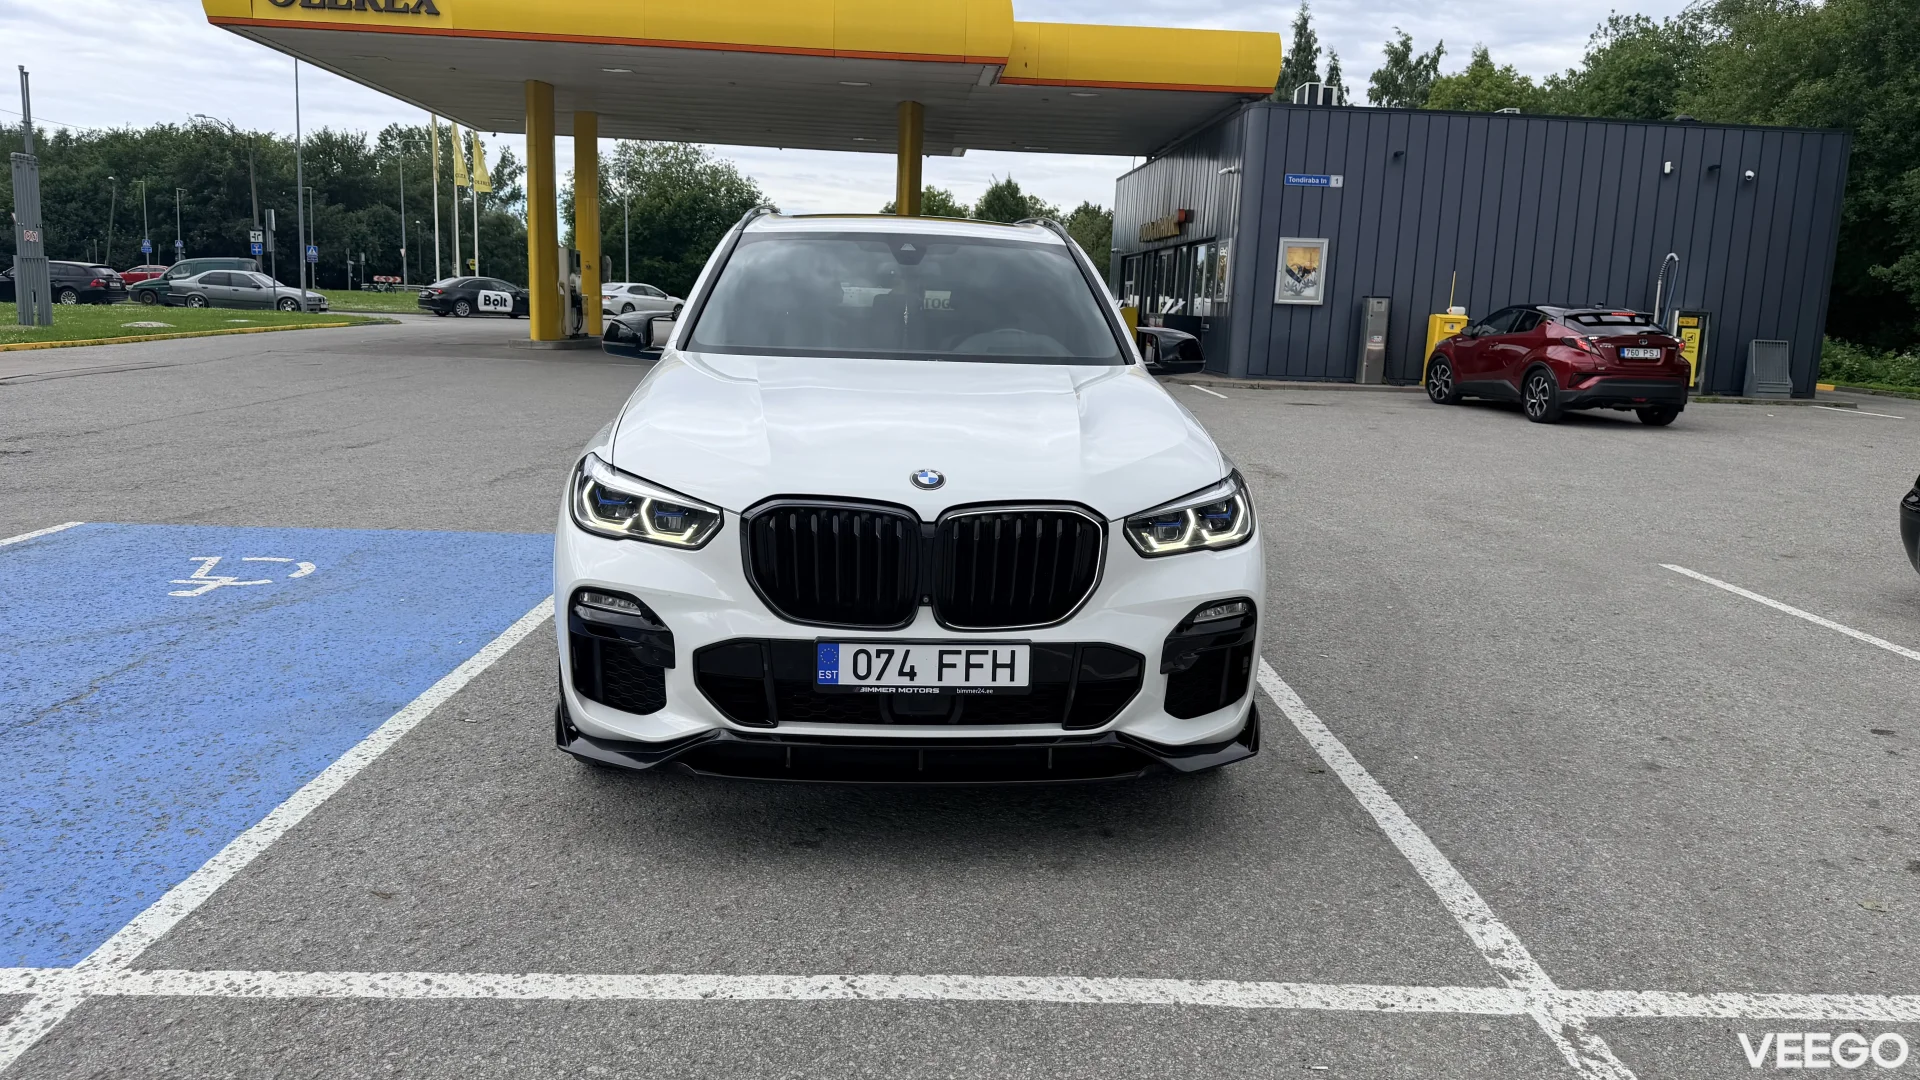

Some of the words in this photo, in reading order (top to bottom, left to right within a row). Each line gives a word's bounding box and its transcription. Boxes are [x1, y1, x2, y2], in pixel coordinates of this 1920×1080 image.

[1288, 176, 1320, 184] Tondiraba
[483, 294, 507, 307] Bolt
[1626, 348, 1640, 357] 760
[1643, 349, 1659, 357] PSJ
[852, 648, 917, 682] 074
[937, 649, 1016, 682] FFH
[818, 670, 838, 679] EST
[898, 686, 940, 694] MOTORS
[956, 687, 994, 695] bimmer24.ee
